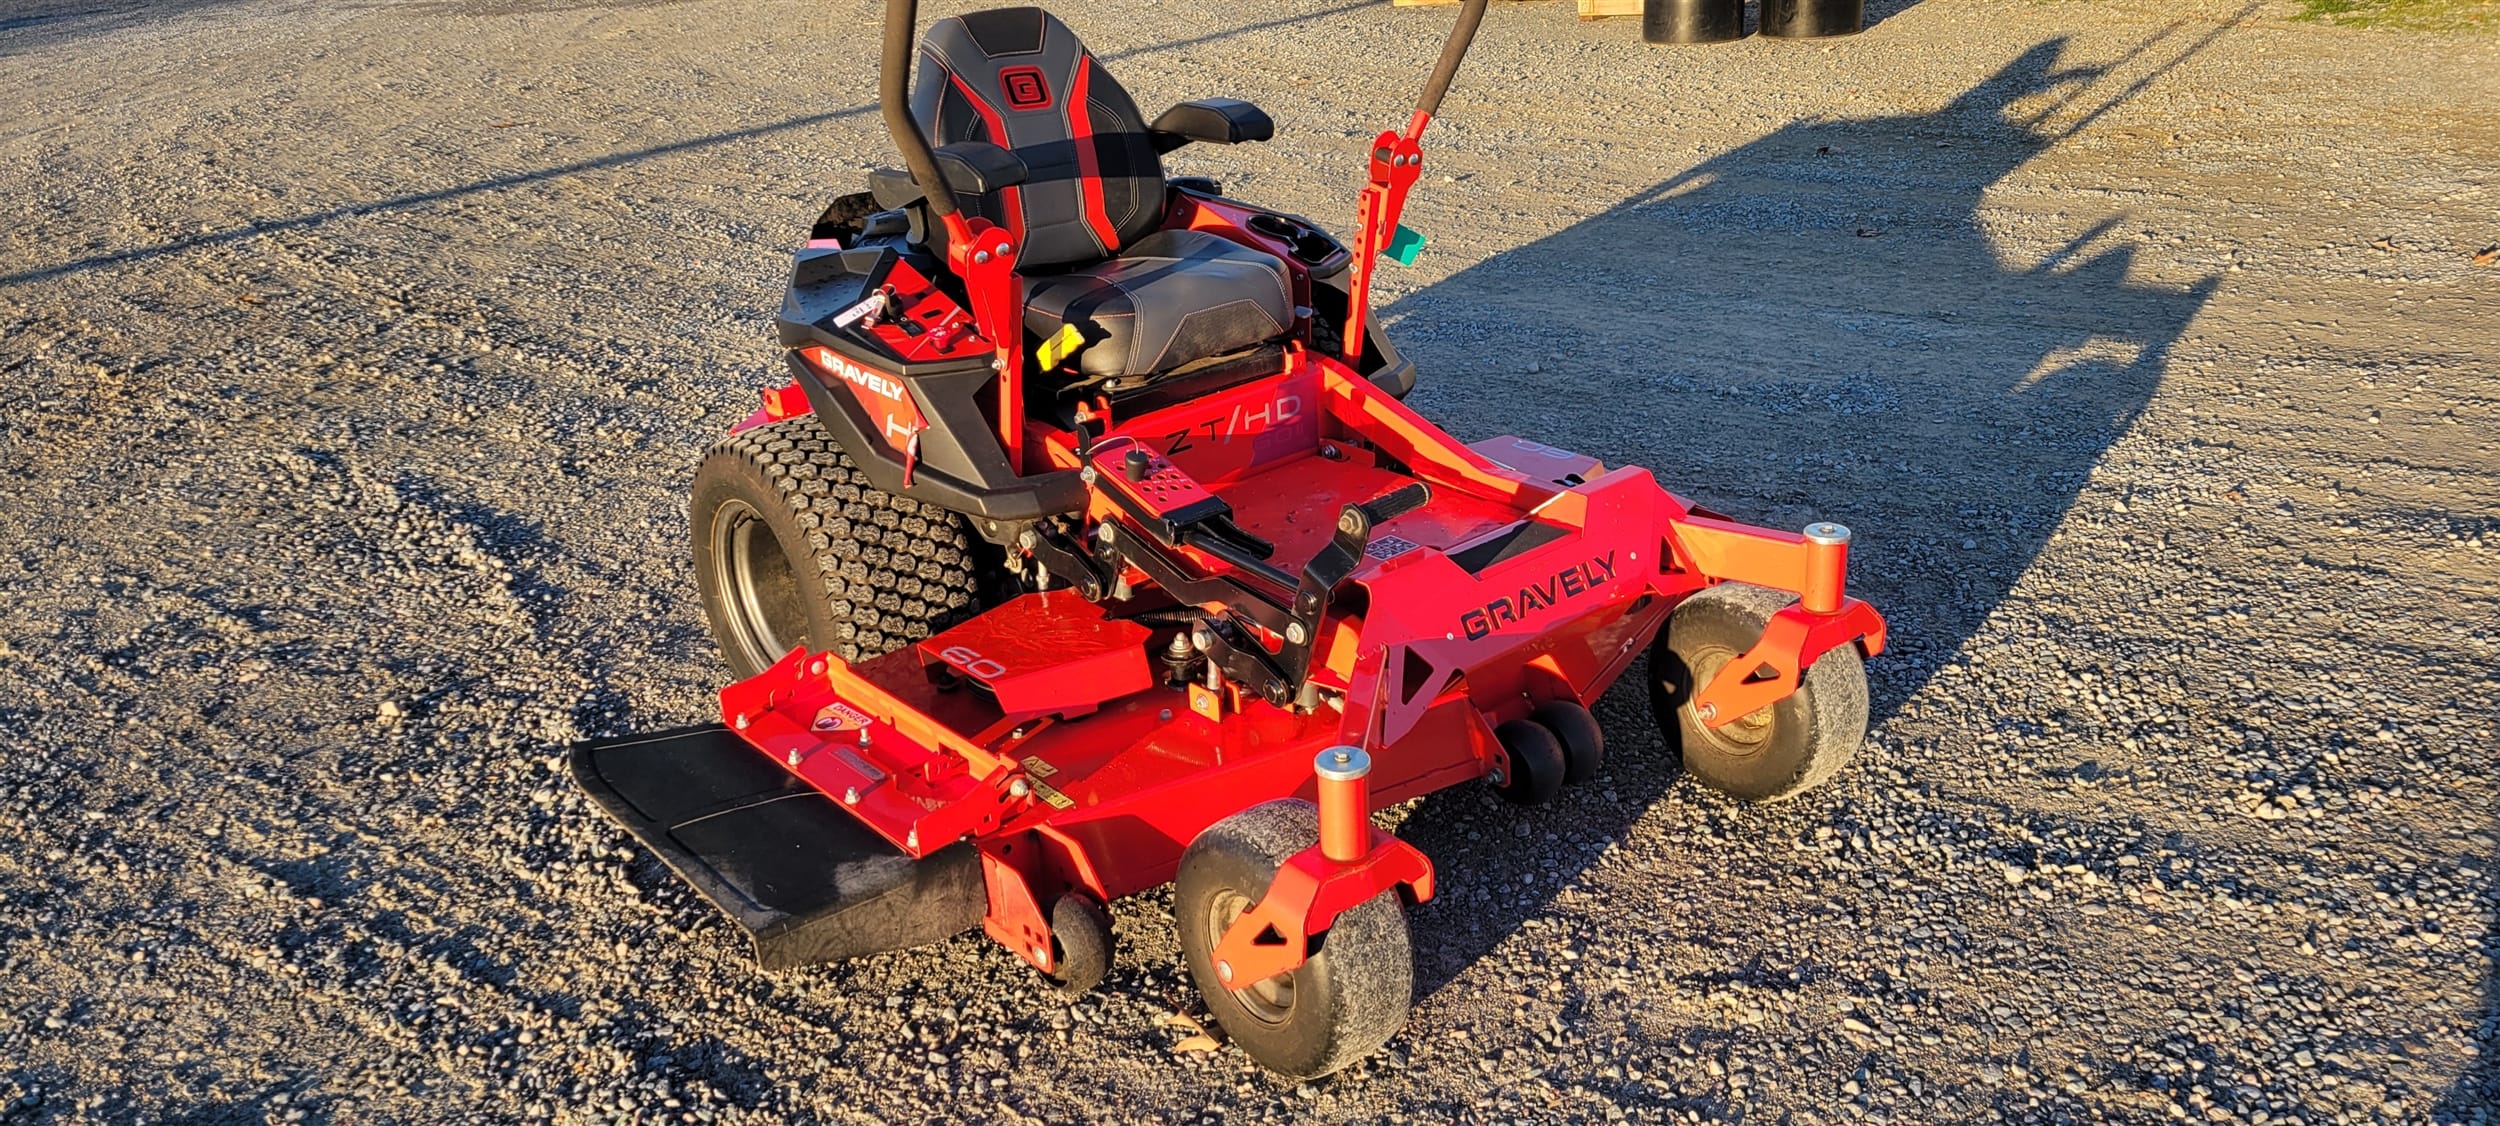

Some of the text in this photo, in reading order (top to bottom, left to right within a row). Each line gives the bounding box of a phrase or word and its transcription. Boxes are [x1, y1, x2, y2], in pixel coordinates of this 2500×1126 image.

[820, 349, 904, 402] GRAVELY
[886, 412, 918, 446] H
[1460, 549, 1616, 641] GRAVELY
[941, 646, 1006, 678] 60
[833, 704, 869, 724] DANGER
